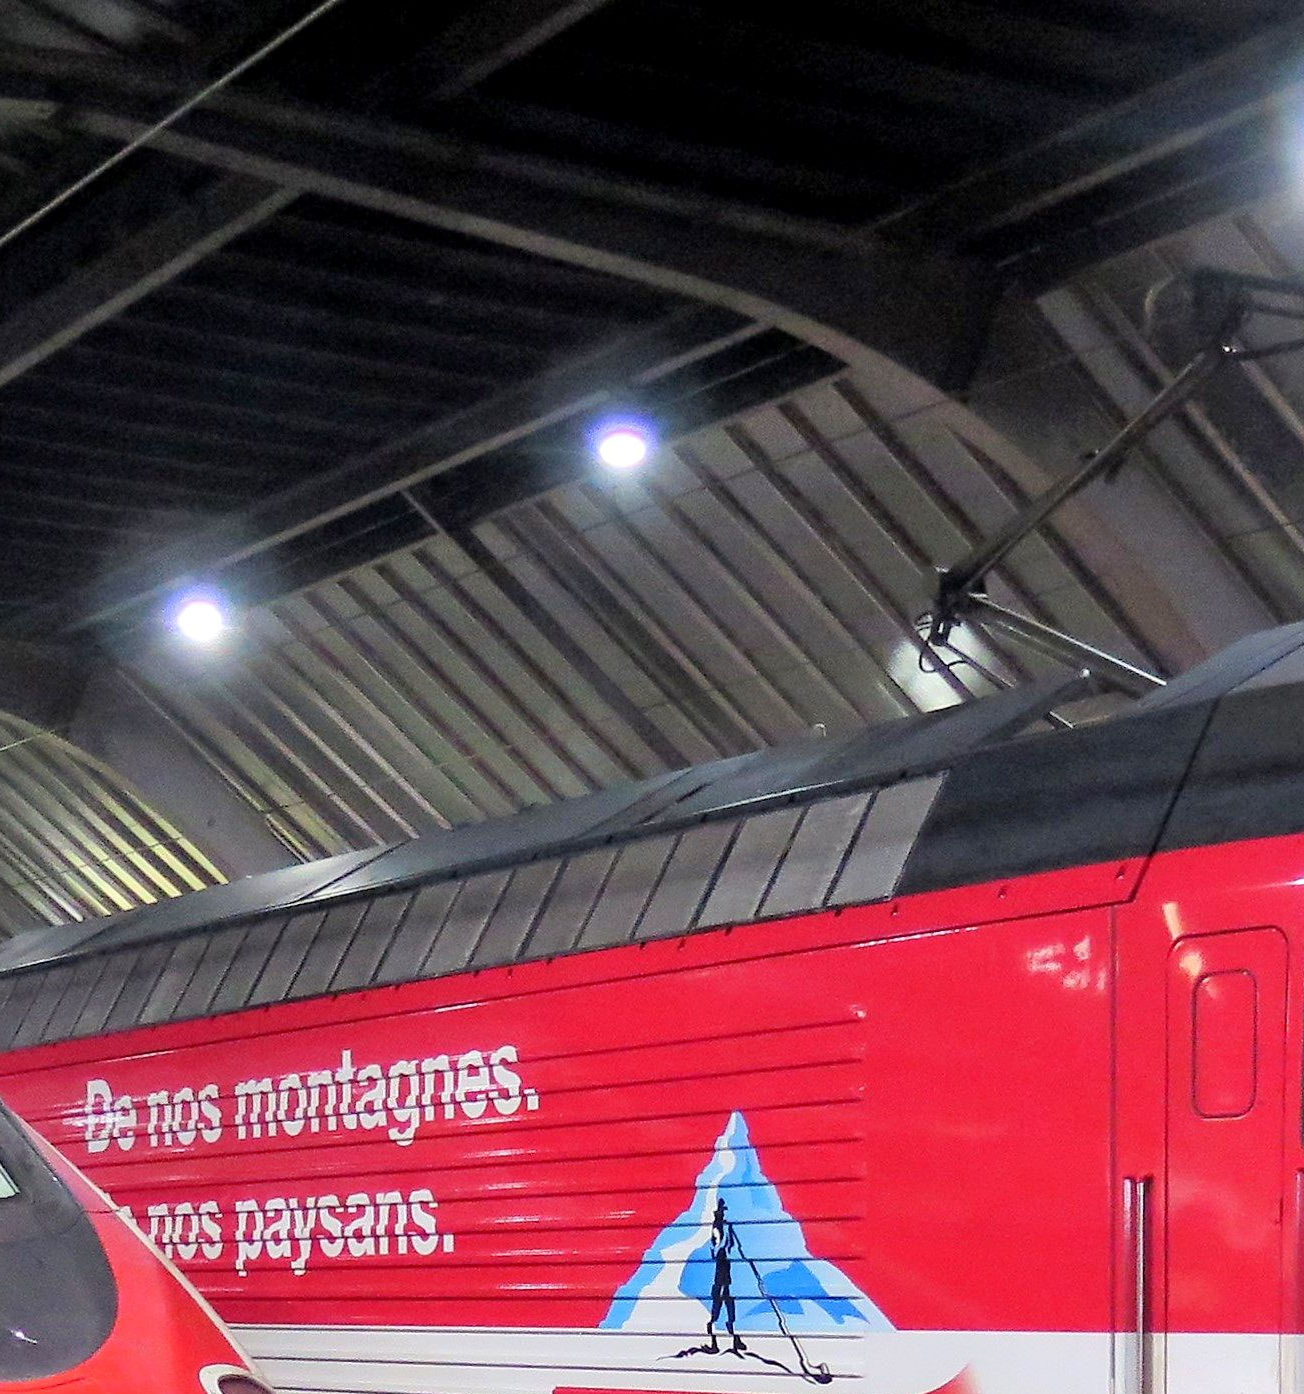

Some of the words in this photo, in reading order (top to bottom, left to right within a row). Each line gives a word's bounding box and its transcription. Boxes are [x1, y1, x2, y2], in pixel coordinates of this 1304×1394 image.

[84, 1078, 138, 1153] De
[147, 1083, 223, 1148] nos
[234, 1044, 539, 1147] montagnes.
[147, 1200, 224, 1261] nos
[235, 1188, 455, 1277] paysans.
